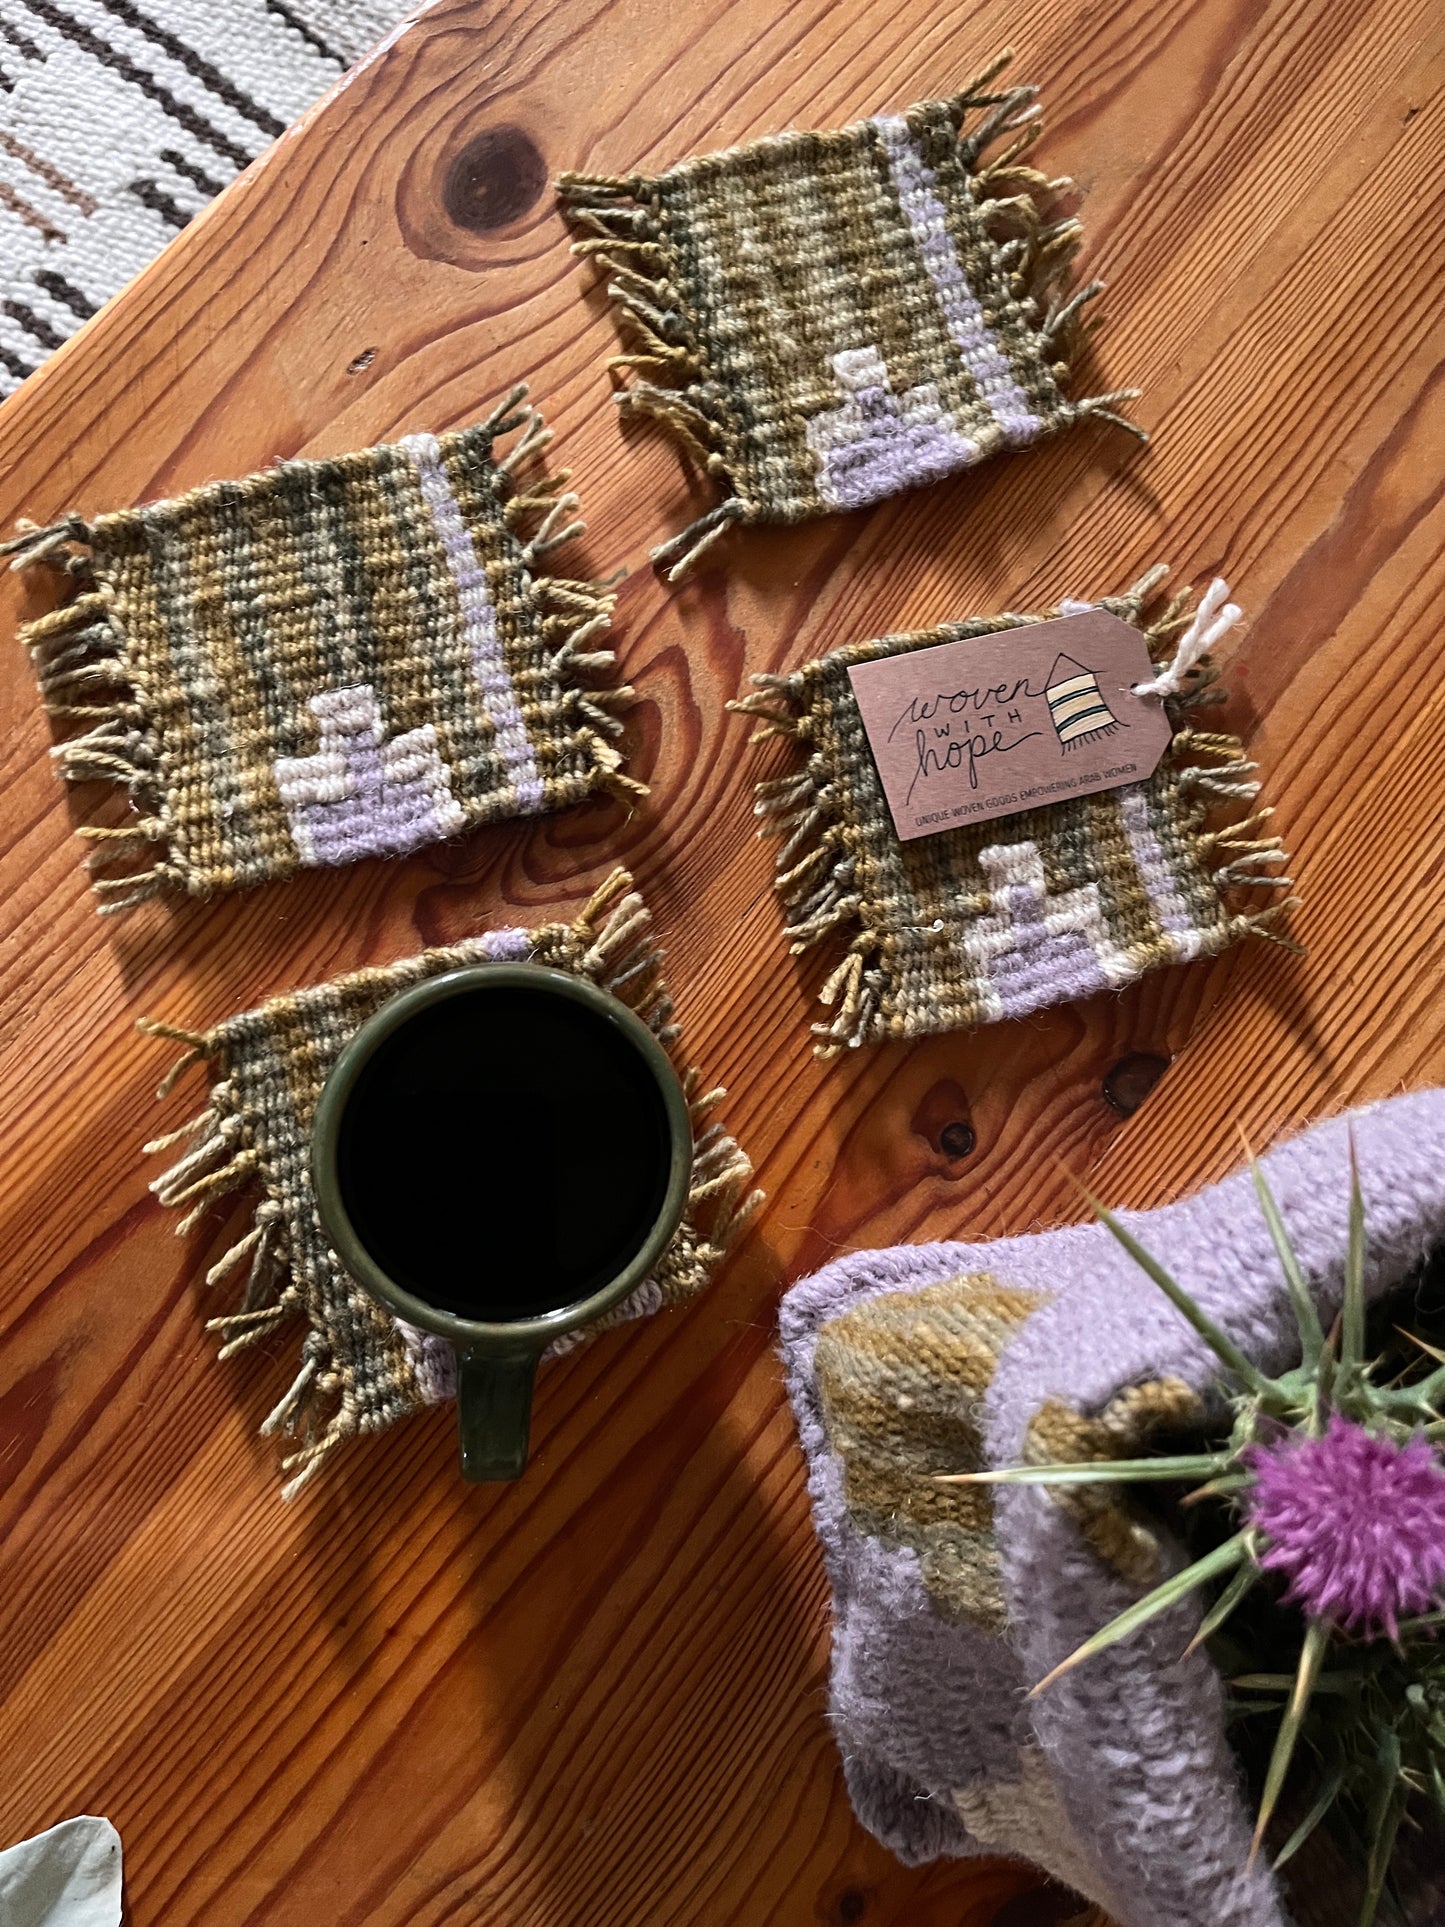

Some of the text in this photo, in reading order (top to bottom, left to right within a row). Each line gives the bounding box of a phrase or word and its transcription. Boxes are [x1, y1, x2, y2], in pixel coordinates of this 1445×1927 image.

[887, 678, 1048, 743] woven
[933, 708, 1023, 739] WITH
[905, 729, 1043, 806] hope
[915, 763, 1138, 827] UNIQUE WOVEN GOODS EMPOWERING ARAB WOMEN
